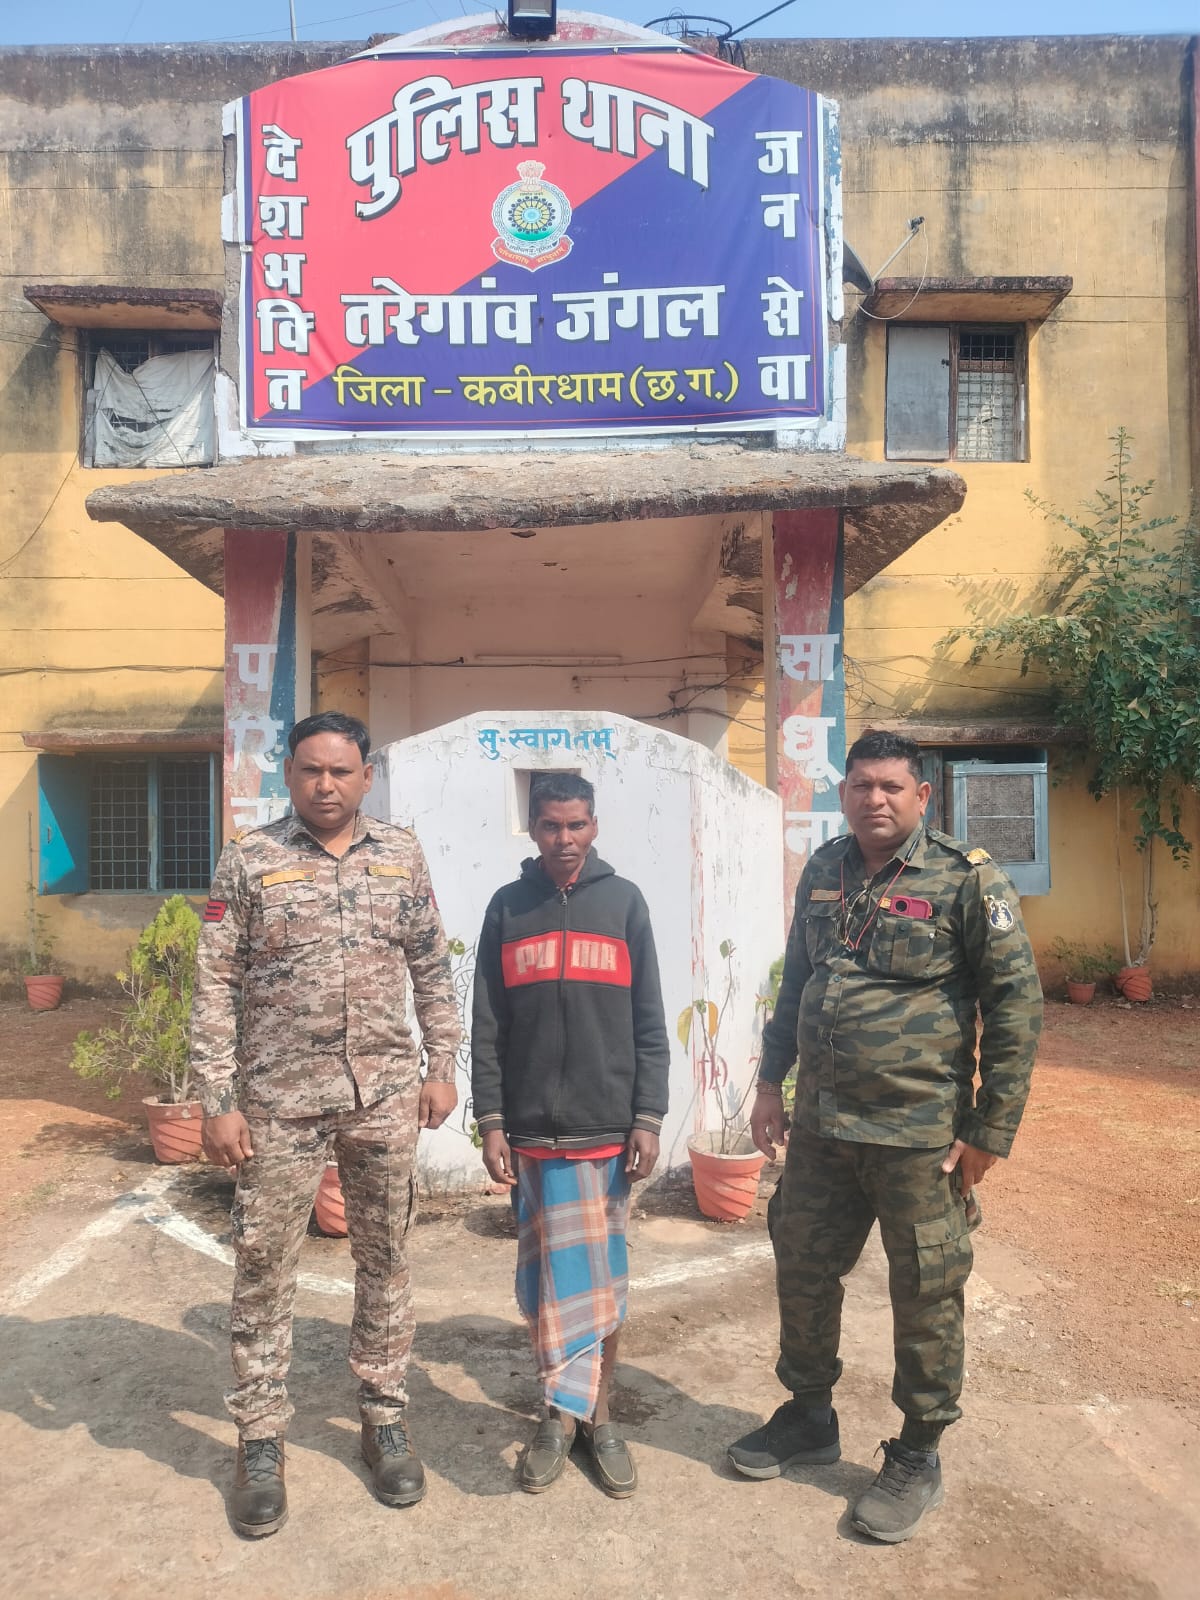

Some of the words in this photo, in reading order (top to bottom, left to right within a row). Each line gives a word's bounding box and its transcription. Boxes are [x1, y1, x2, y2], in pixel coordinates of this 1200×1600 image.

[346, 75, 544, 220] पुलिस
[561, 77, 714, 189] थाना
[340, 276, 538, 346] तरेगांव
[552, 272, 726, 341] जंगल
[332, 364, 426, 406] जिला
